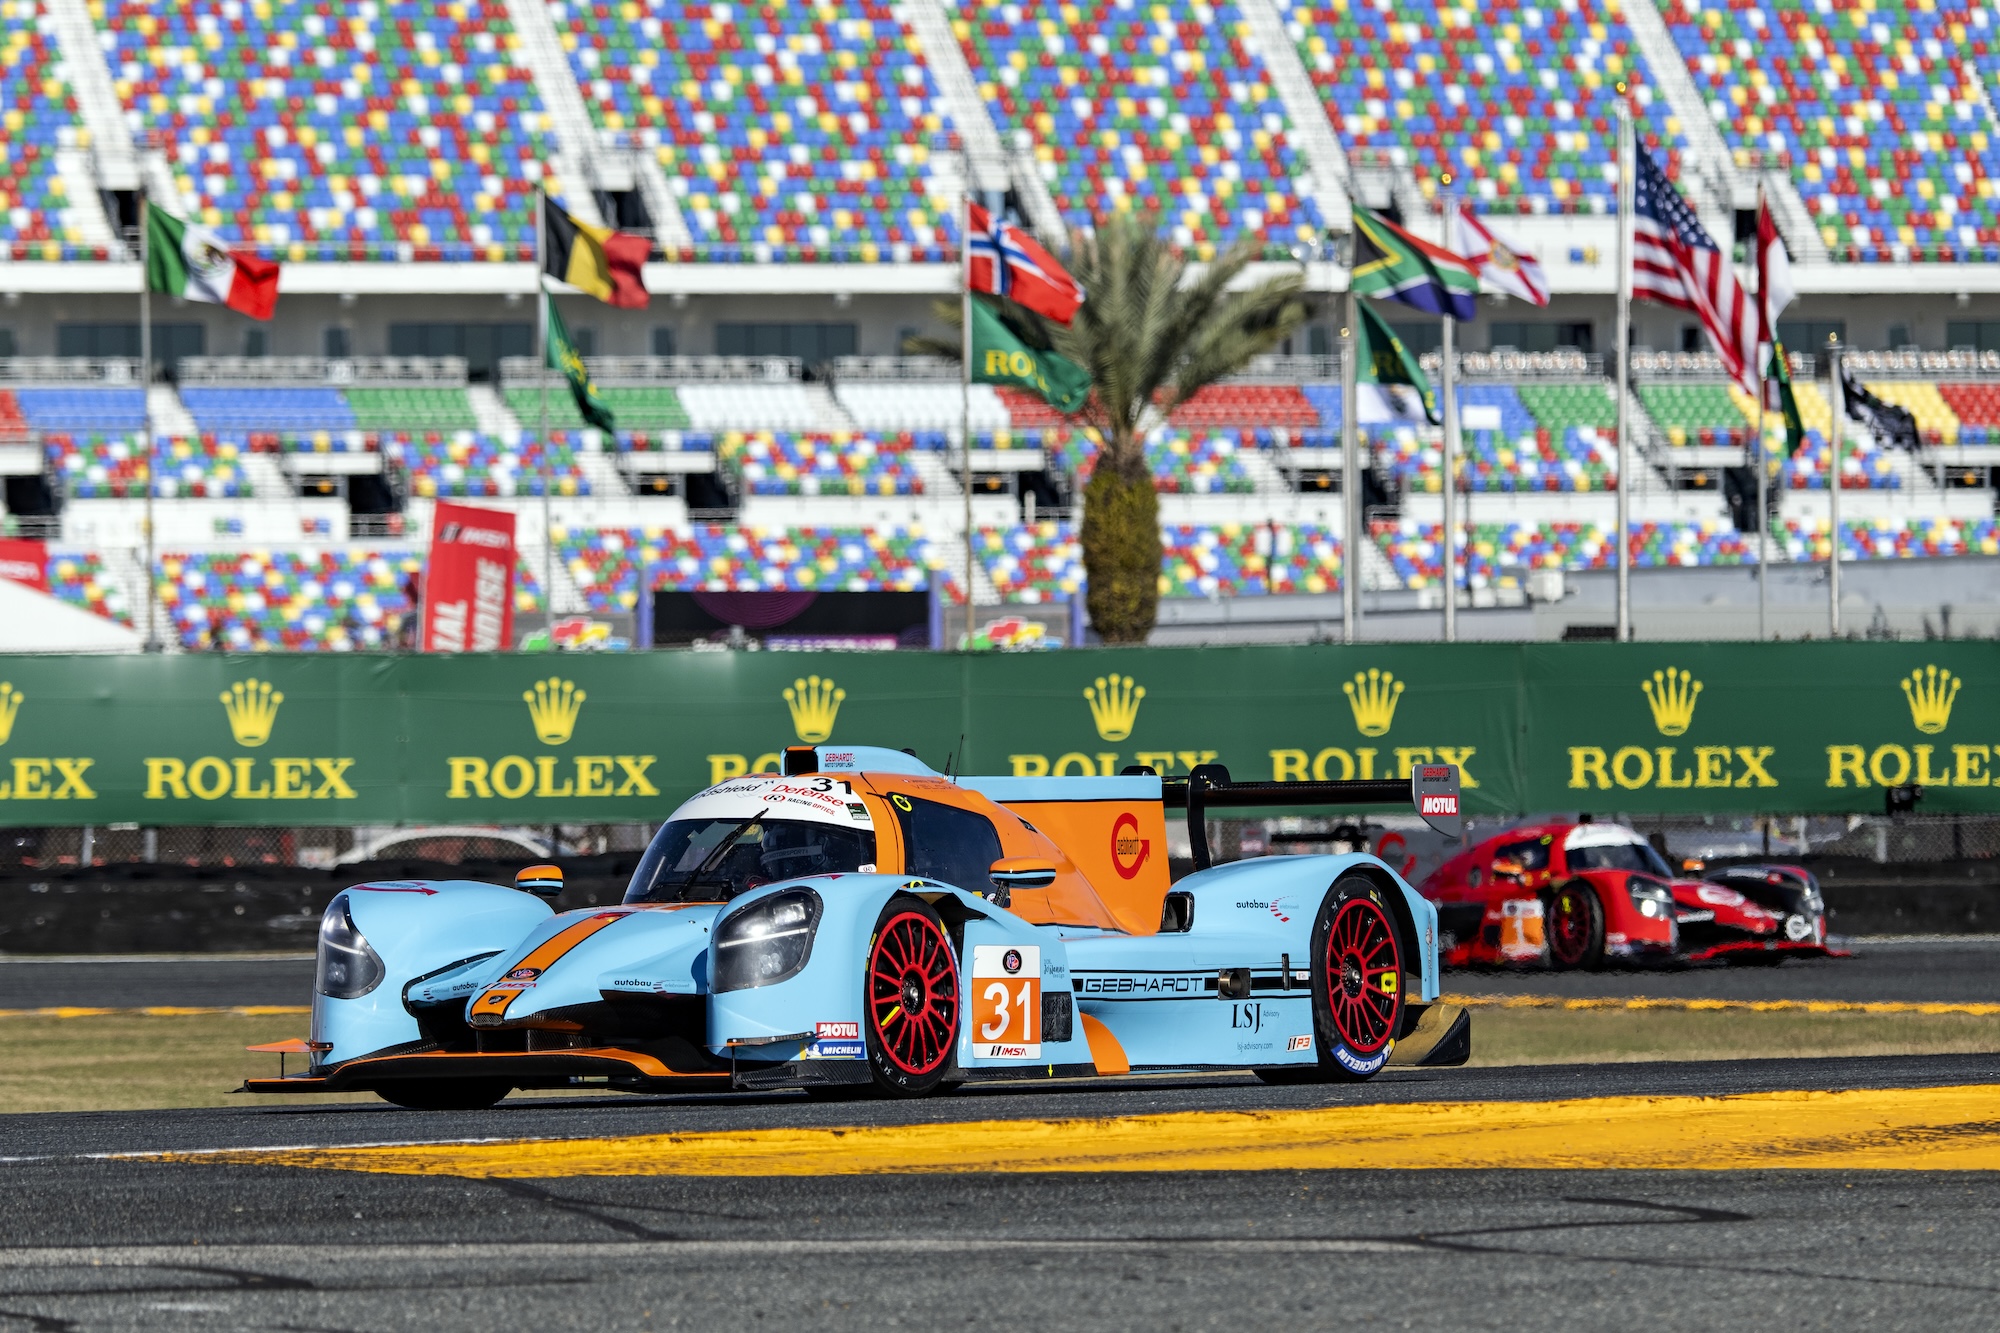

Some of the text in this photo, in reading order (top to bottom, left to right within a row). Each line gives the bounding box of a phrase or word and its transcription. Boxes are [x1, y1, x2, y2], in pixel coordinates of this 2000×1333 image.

[825, 753, 853, 762] GEBHARDT
[1567, 744, 1778, 790] ROLEX
[1825, 743, 2000, 789] ROLE
[144, 756, 358, 800] ROLEX
[447, 754, 661, 799] ROLEX
[811, 777, 853, 795] 31
[771, 784, 845, 807] Defense
[787, 797, 812, 807] RACING
[1423, 797, 1457, 814] MOTUL
[1236, 898, 1269, 909] autobau
[452, 981, 479, 992] autobau
[614, 978, 652, 987] autobau
[1085, 978, 1203, 993] GEBHARDT
[981, 981, 1031, 1041] 31
[818, 1023, 858, 1037] MOTUL
[822, 1046, 862, 1055] MICHELIN
[1001, 1047, 1027, 1056] IMSA
[1336, 1048, 1383, 1072] MICHELIN
